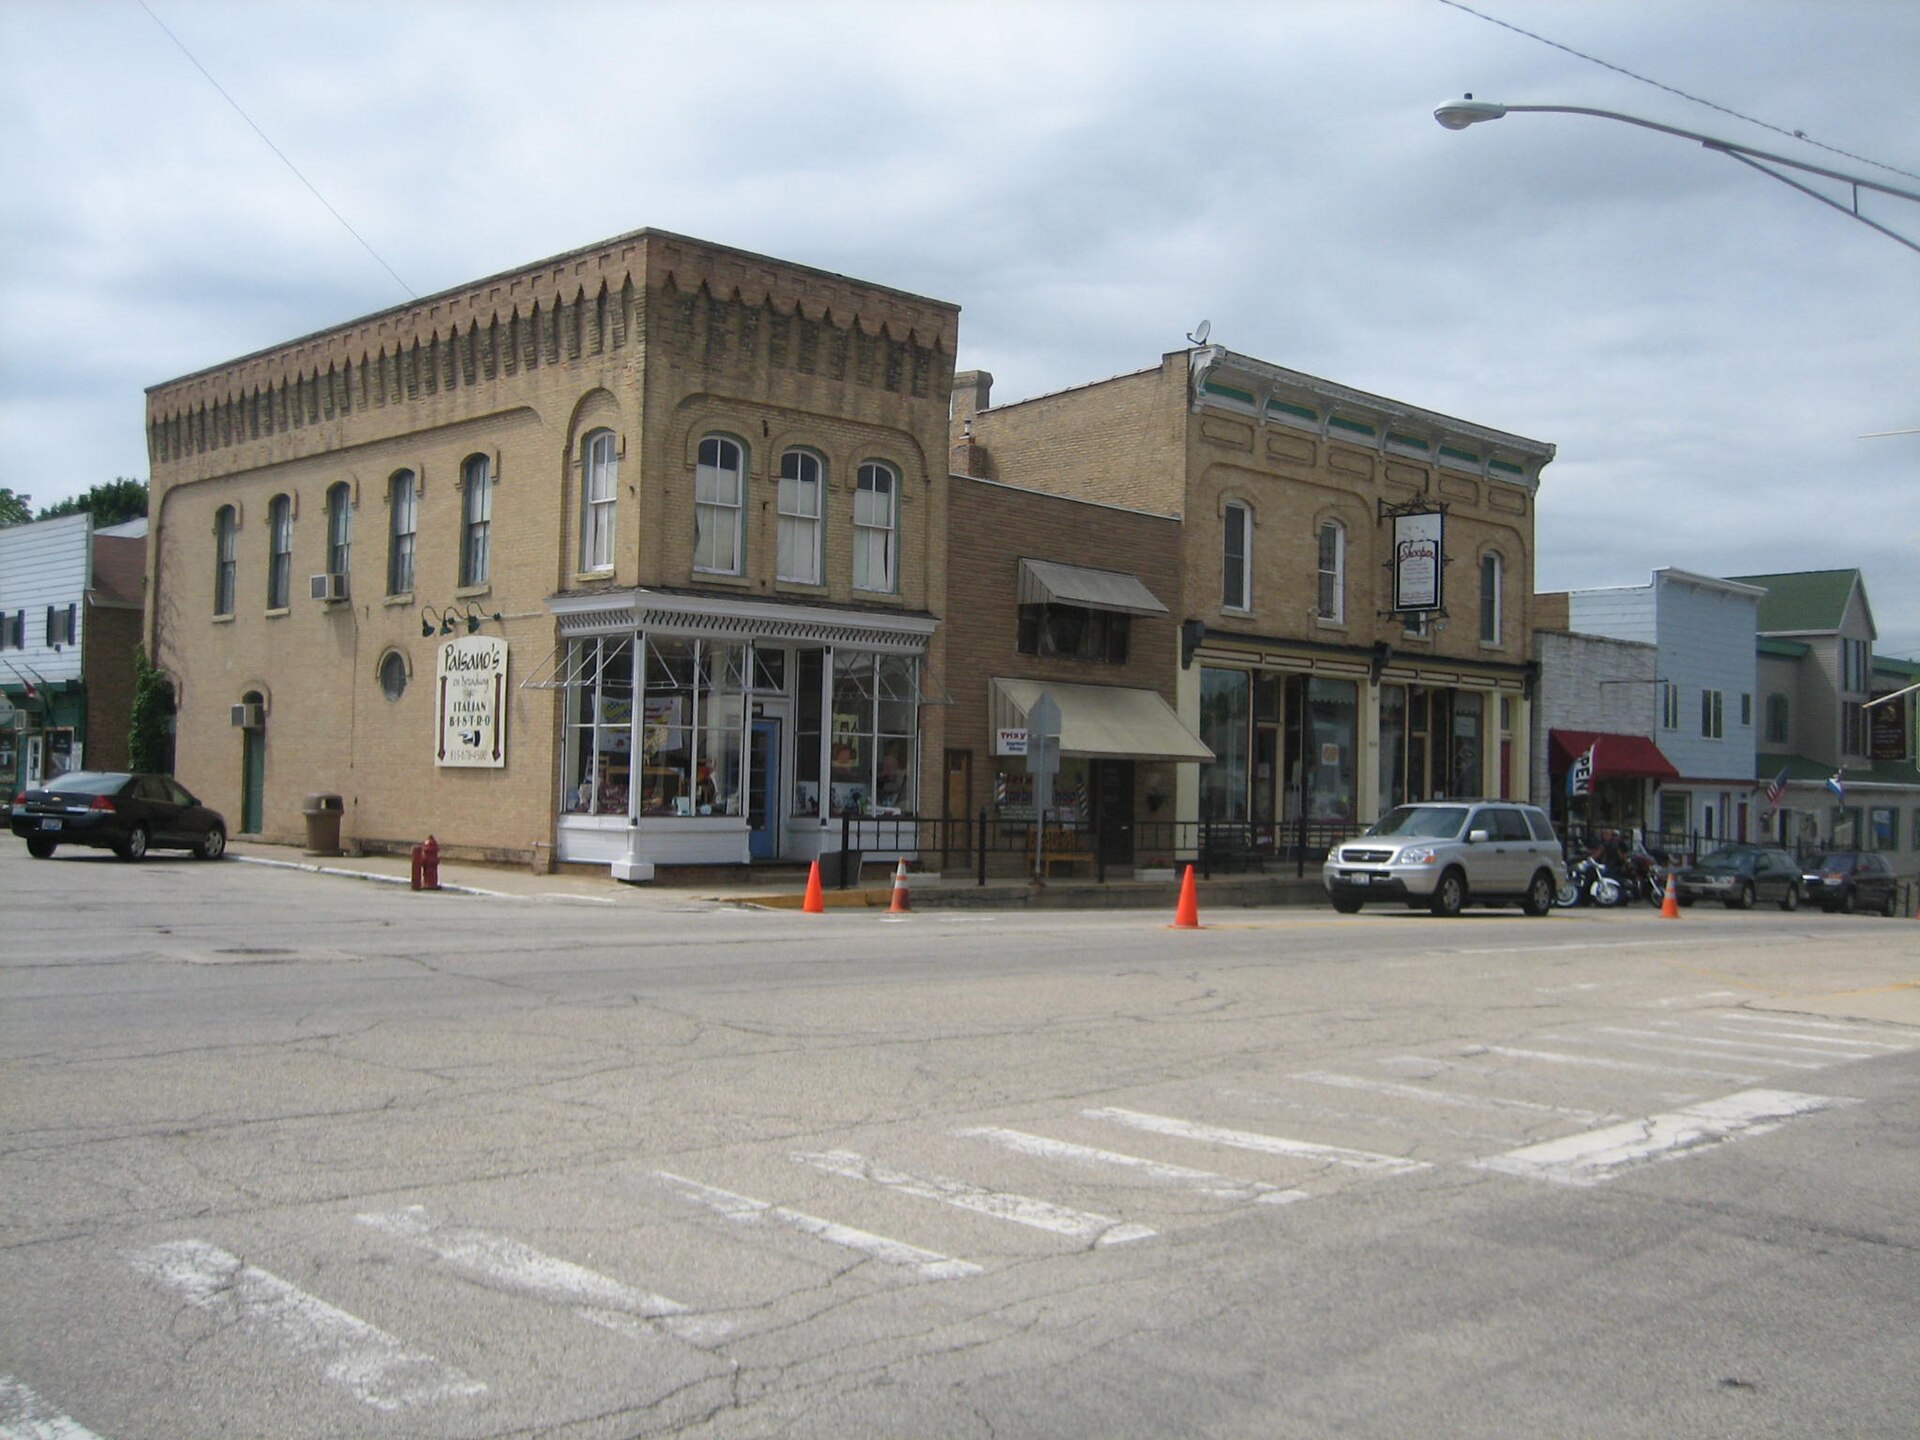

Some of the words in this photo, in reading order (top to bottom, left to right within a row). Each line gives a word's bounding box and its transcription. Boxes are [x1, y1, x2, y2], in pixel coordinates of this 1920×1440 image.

[445, 643, 500, 672] Paisano's
[453, 701, 486, 713] ITALIAN
[1575, 754, 1591, 791] PEN
